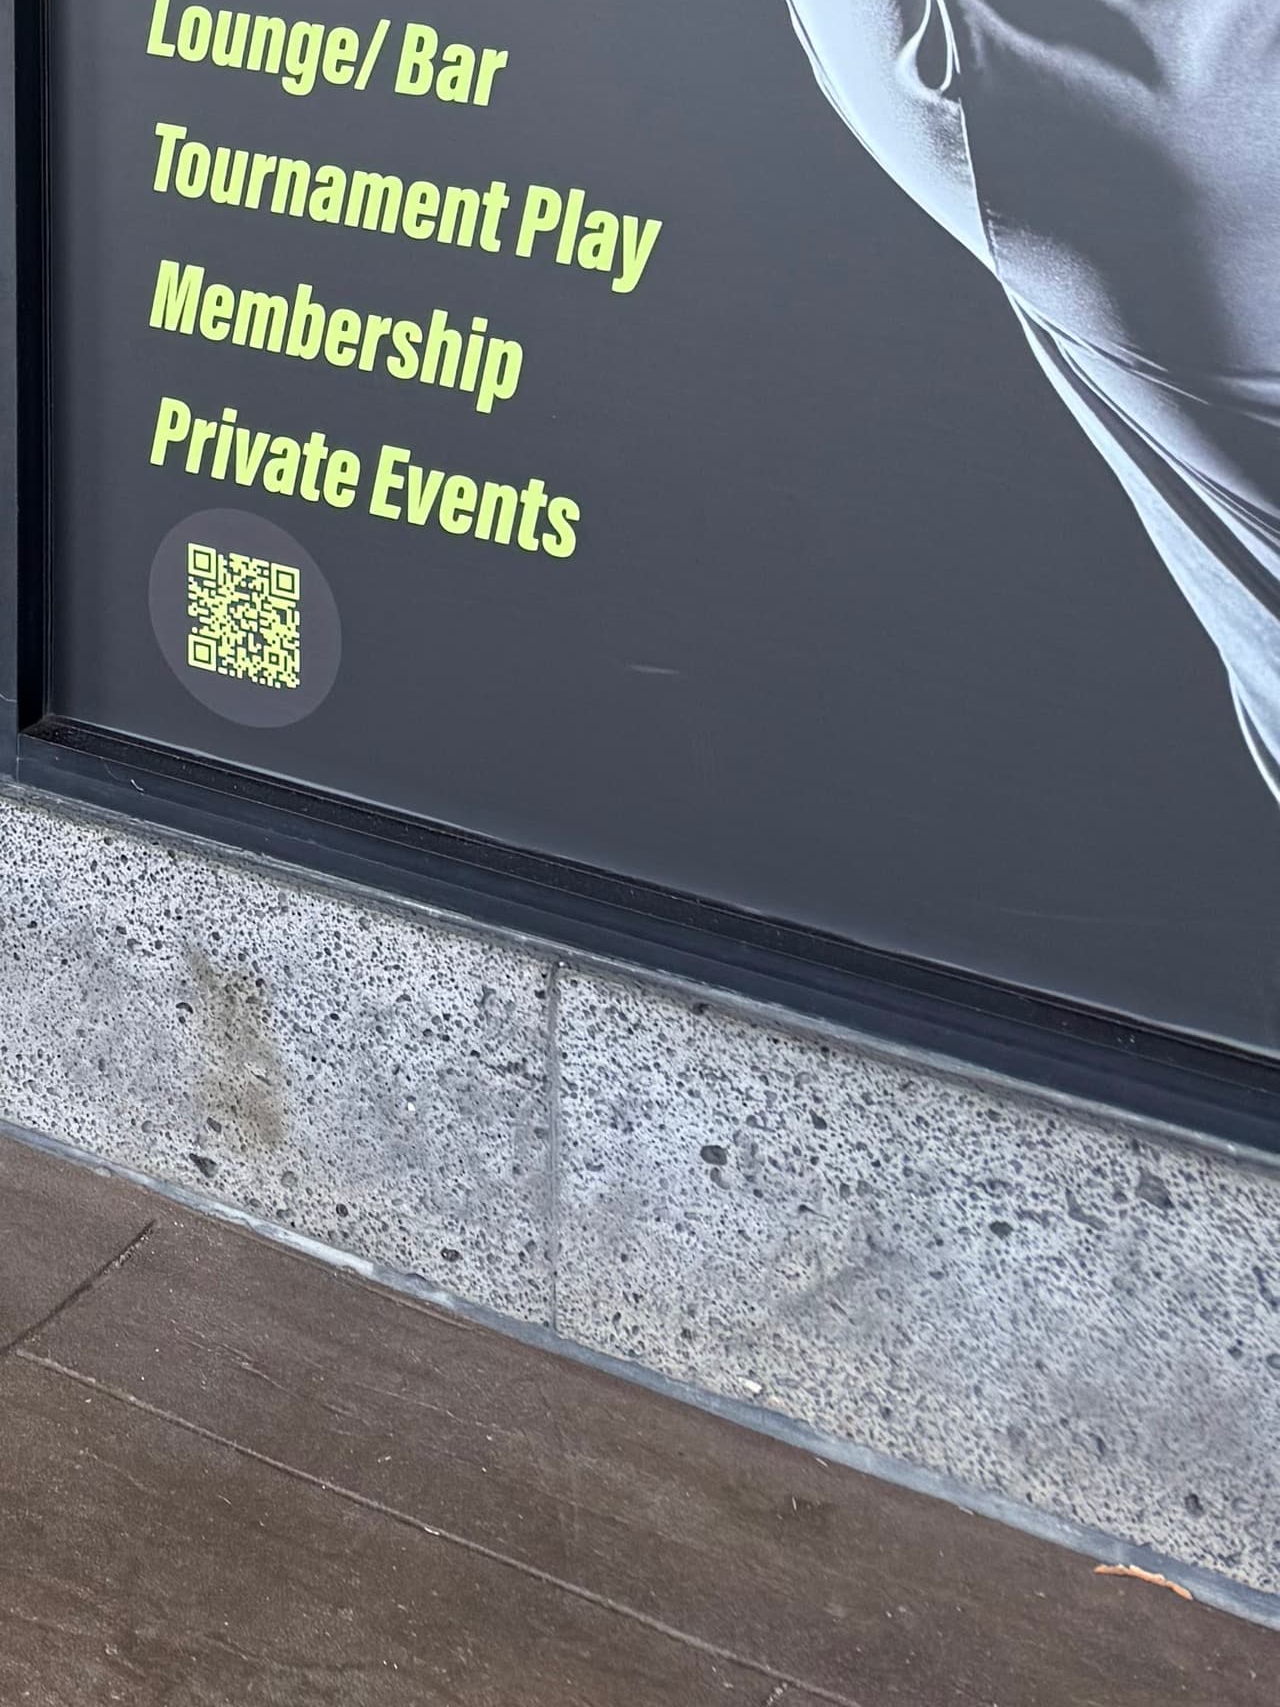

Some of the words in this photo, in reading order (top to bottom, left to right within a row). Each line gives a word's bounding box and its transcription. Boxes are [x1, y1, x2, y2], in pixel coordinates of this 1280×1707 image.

[394, 23, 509, 106] Bar
[153, 122, 510, 252] Tournament
[515, 185, 663, 293] Play
[149, 259, 523, 413] Membership
[150, 397, 361, 508] Private
[369, 444, 580, 558] Events
